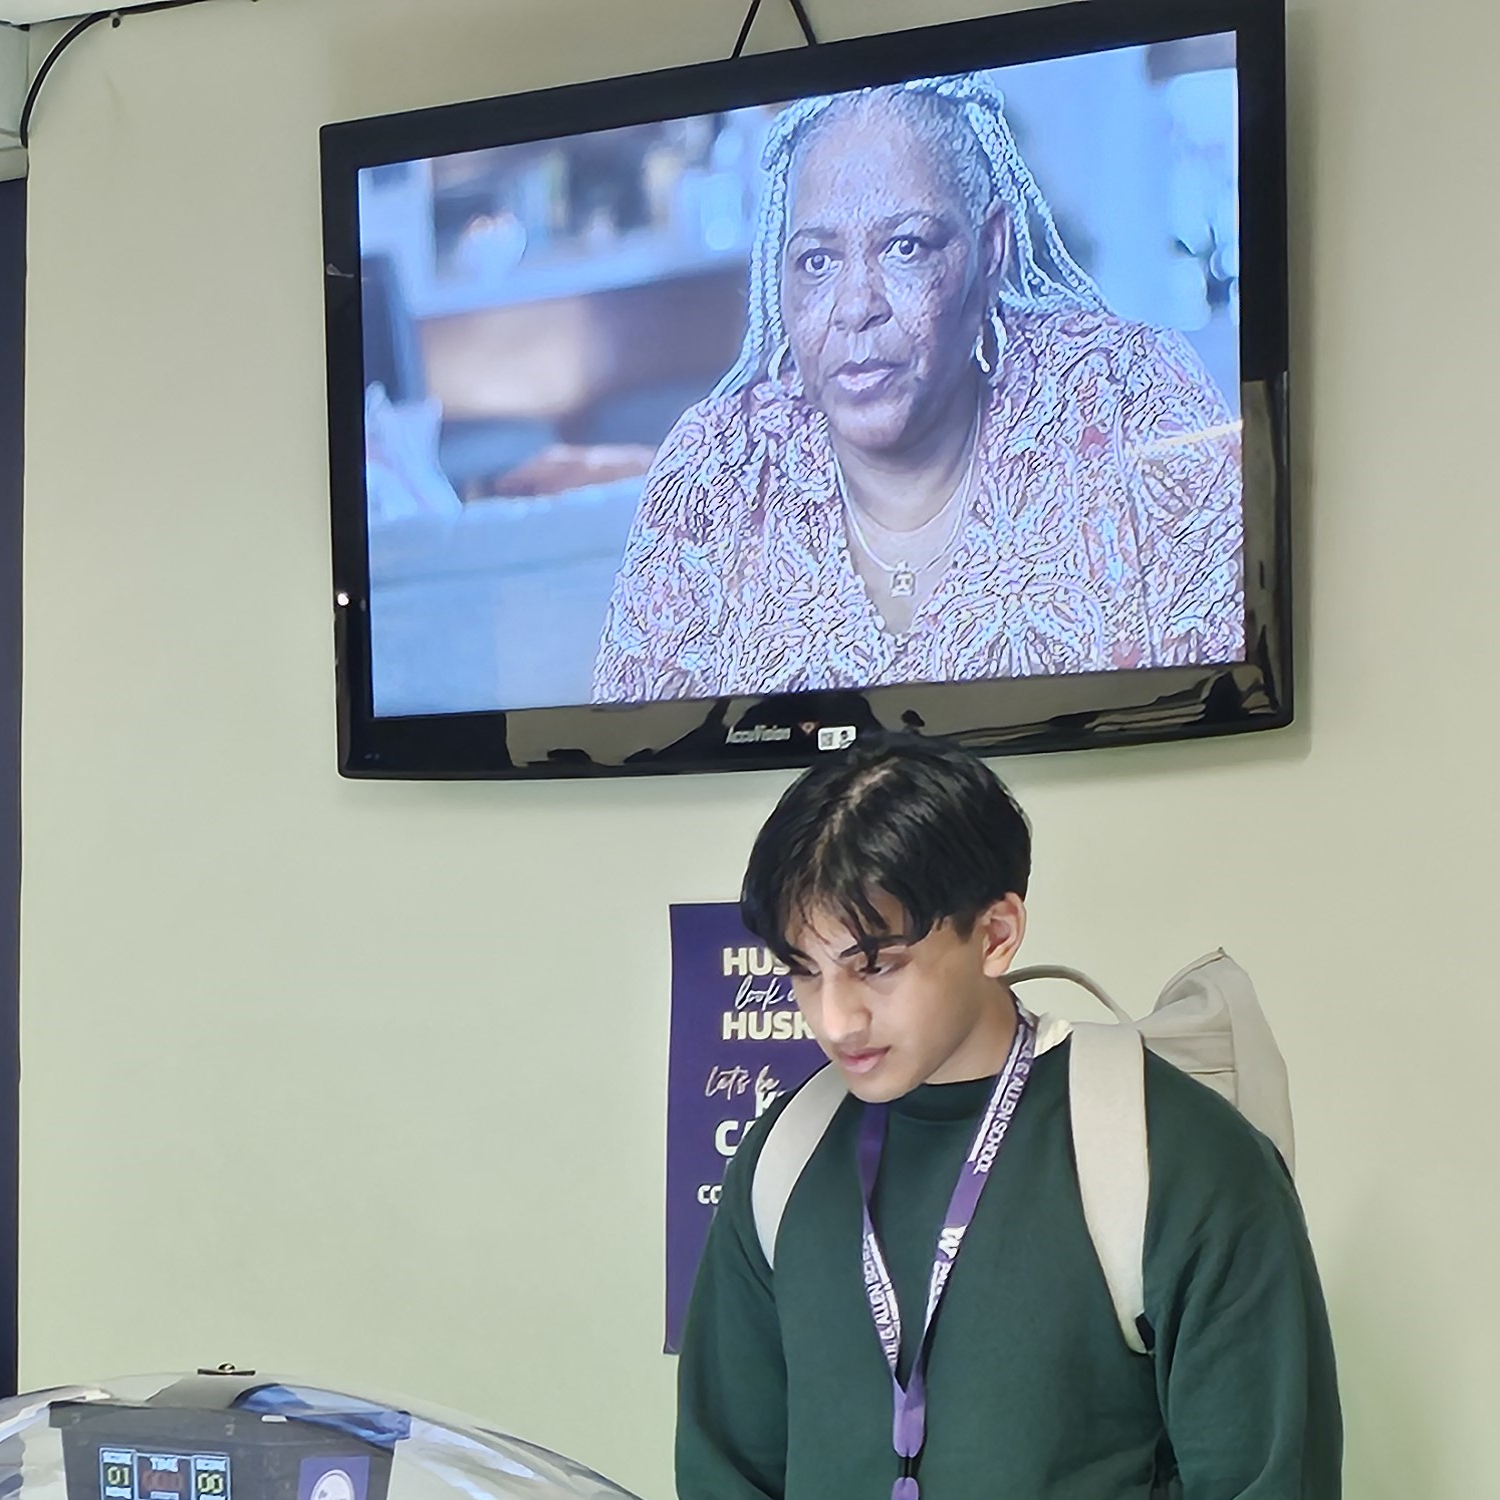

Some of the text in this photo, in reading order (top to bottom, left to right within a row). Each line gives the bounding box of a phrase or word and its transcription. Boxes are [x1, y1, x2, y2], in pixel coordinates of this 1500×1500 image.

[723, 947, 790, 976] HUS
[735, 975, 784, 1011] look
[723, 1011, 817, 1040] HUSK
[973, 1119, 1009, 1175] SCHOOL
